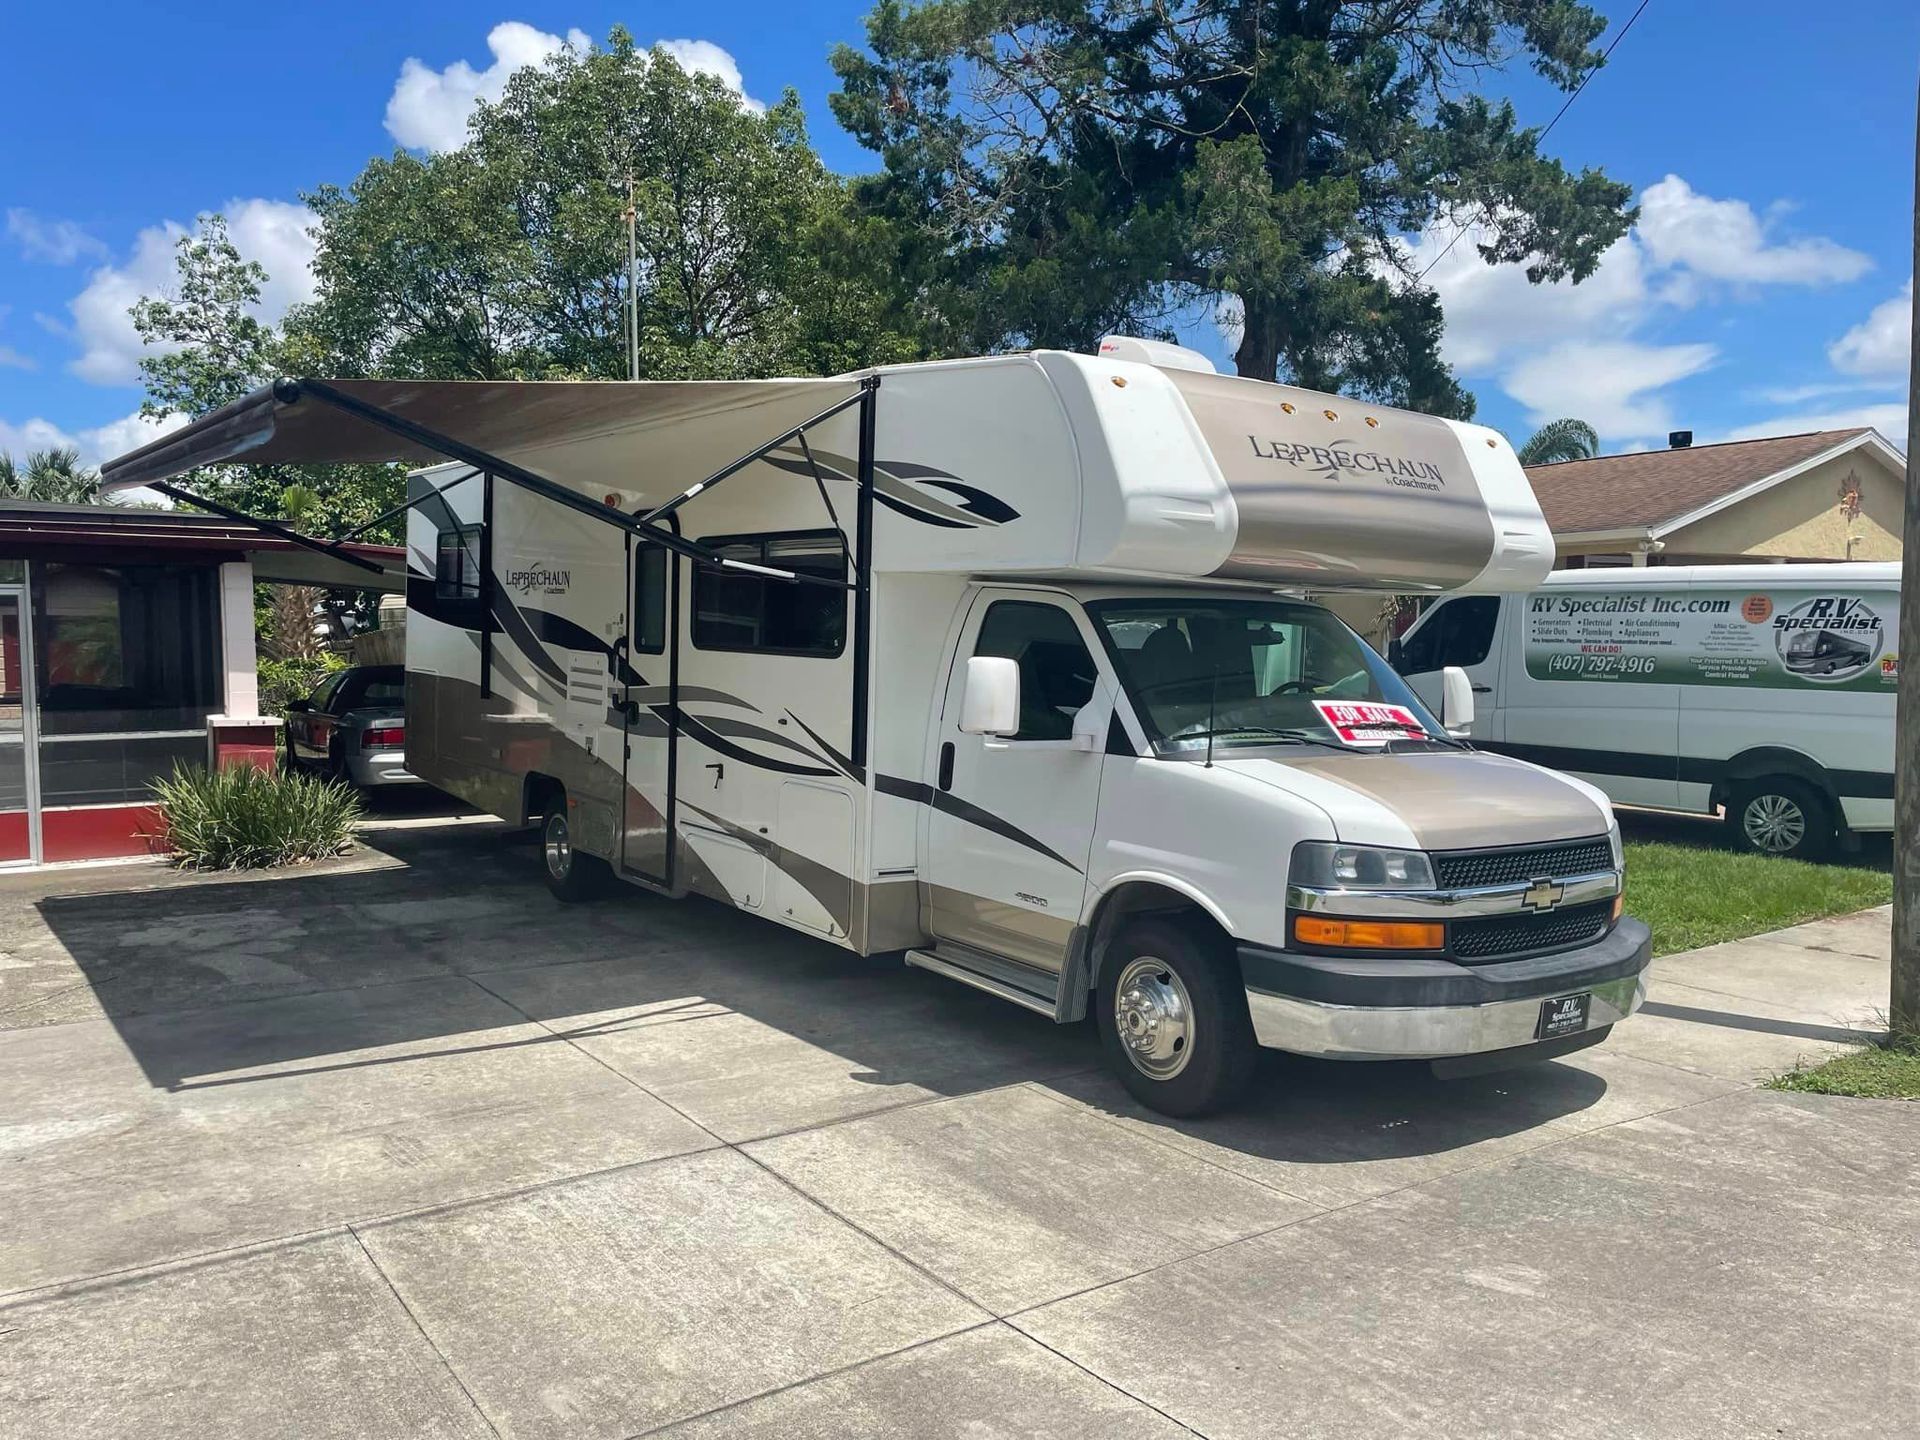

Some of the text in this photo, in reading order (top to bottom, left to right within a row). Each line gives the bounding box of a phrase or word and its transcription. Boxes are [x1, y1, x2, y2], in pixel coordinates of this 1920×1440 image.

[1248, 435, 1445, 485] LEPRECHAUN
[1393, 477, 1440, 492] Coachmen
[506, 570, 570, 588] LEPRECHAUN
[1532, 597, 1557, 613] RV
[1559, 596, 1647, 616] Specialist
[1652, 597, 1731, 613] Inc.com
[1538, 618, 1680, 629] Generators Electrical Air Conditioning
[1772, 613, 1882, 632] Specialist
[1581, 628, 1612, 637] Plumbing
[1624, 628, 1660, 637] Appliances
[1581, 645, 1592, 653] WE
[1594, 645, 1607, 653] CAN
[1549, 655, 1656, 673] (407) 797-4916
[1331, 706, 1398, 722] FOR SALE
[1552, 1008, 1581, 1022] Specialist
